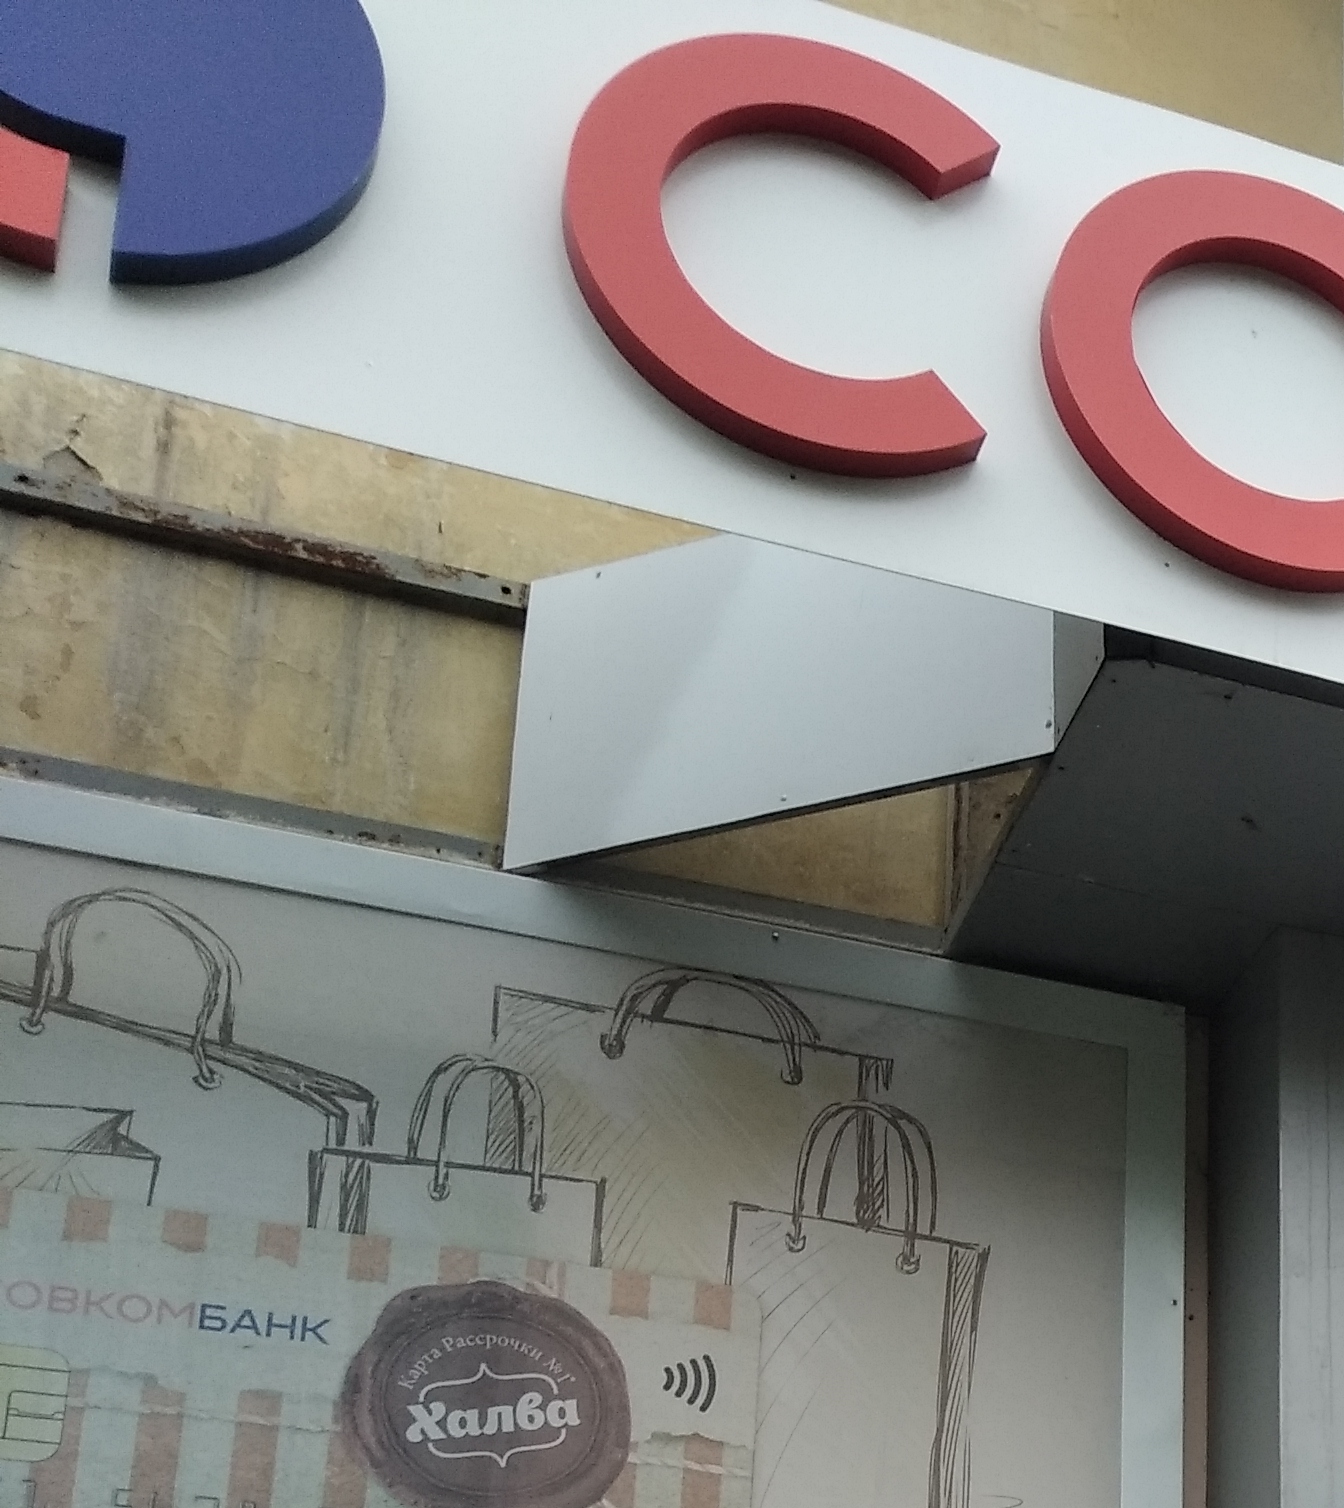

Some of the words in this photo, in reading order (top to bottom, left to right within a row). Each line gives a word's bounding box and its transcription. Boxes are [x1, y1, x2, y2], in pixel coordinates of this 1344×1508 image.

[398, 1346, 443, 1390] Карта
[441, 1333, 544, 1362] Рассрочки
[404, 1391, 581, 1443] Халва
